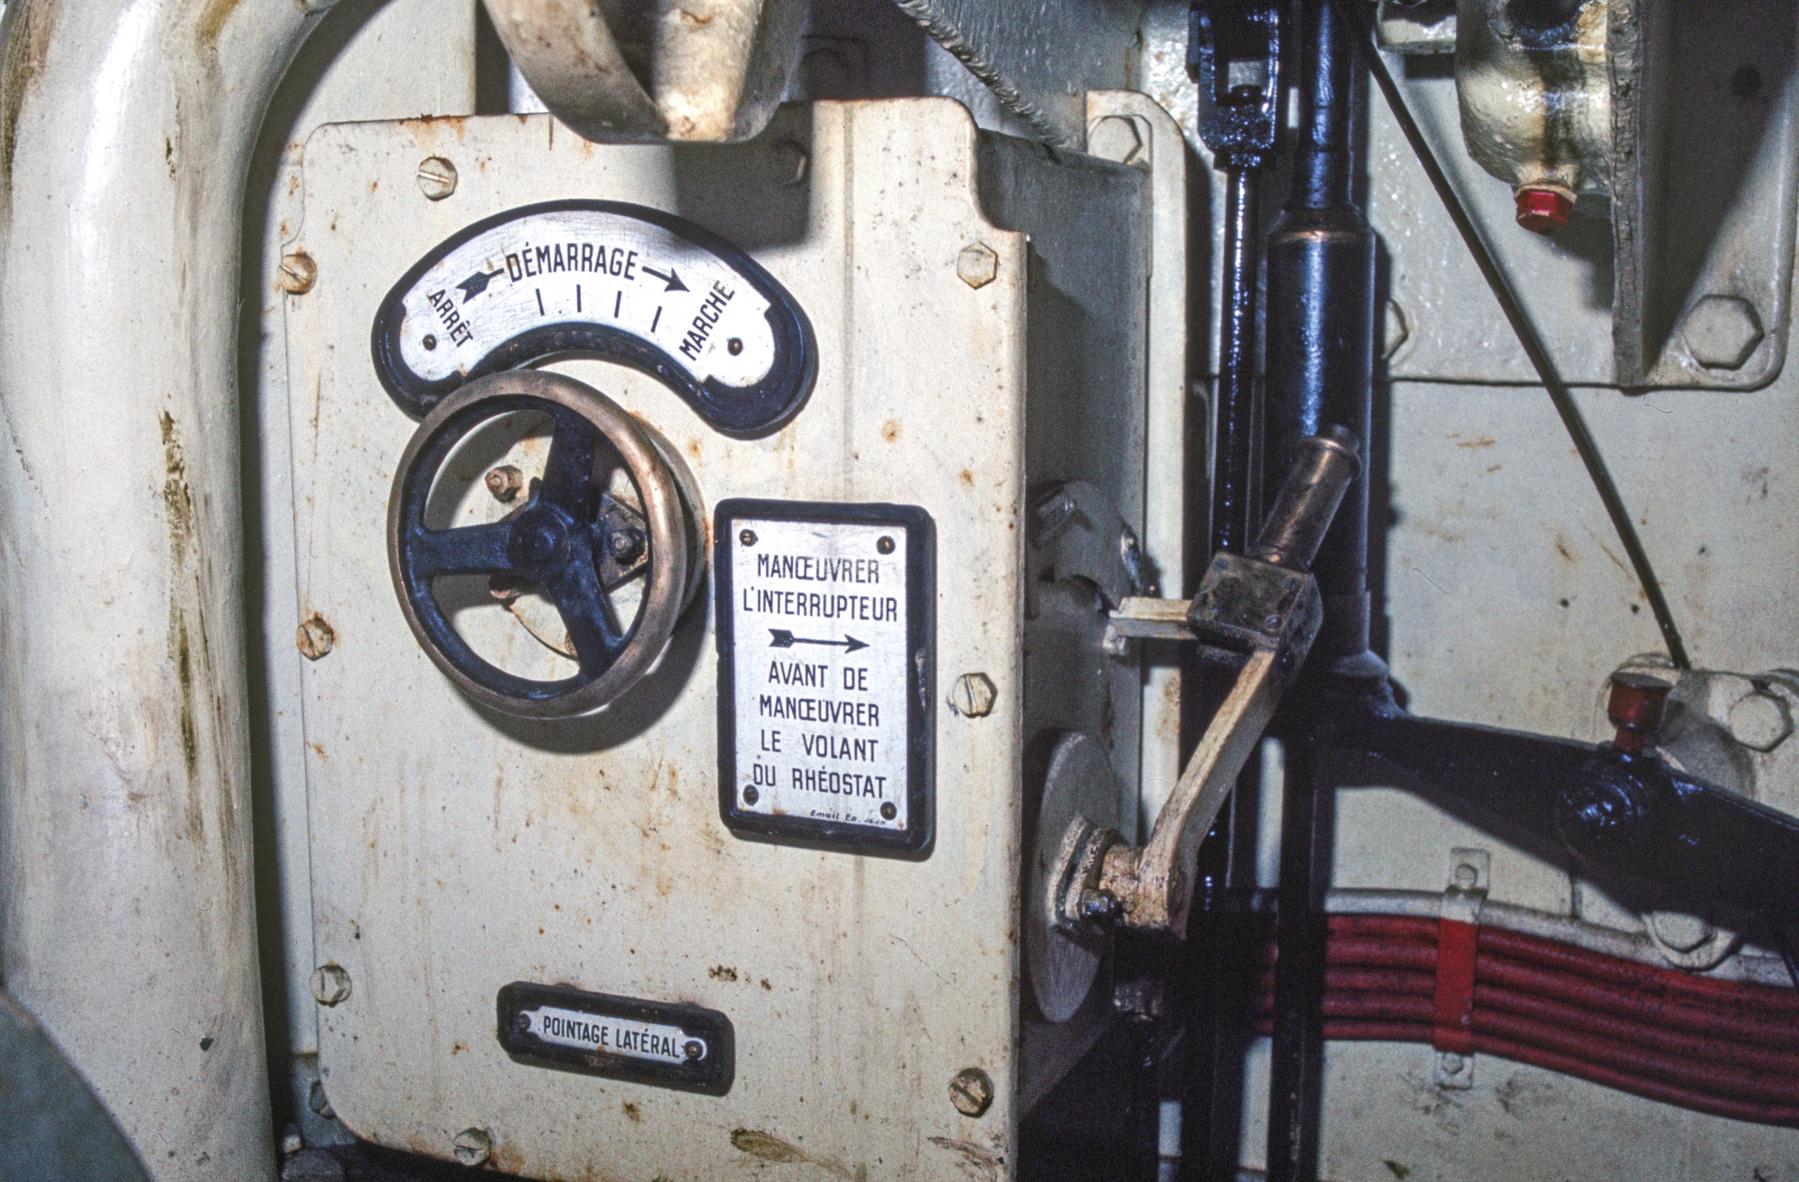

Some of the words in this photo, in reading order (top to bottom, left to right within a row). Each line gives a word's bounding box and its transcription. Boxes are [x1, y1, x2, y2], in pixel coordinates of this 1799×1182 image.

[506, 241, 638, 282] DÉMARRAGE
[428, 288, 473, 348] ARRÊT
[678, 279, 735, 361] MARCHE
[757, 553, 880, 584] MANŒUVRER
[743, 586, 898, 622] L'INTERRUPTEUR
[768, 660, 828, 688] AVANT
[843, 667, 868, 691] DE
[760, 694, 880, 727] MANŒUVRER
[761, 729, 782, 753] LE
[801, 733, 879, 763] VOLANT
[753, 763, 776, 787] DU
[792, 765, 887, 799] RHÉOSTAT
[543, 1016, 609, 1046] POINTAGE
[616, 1028, 681, 1058] LATÉRAL
